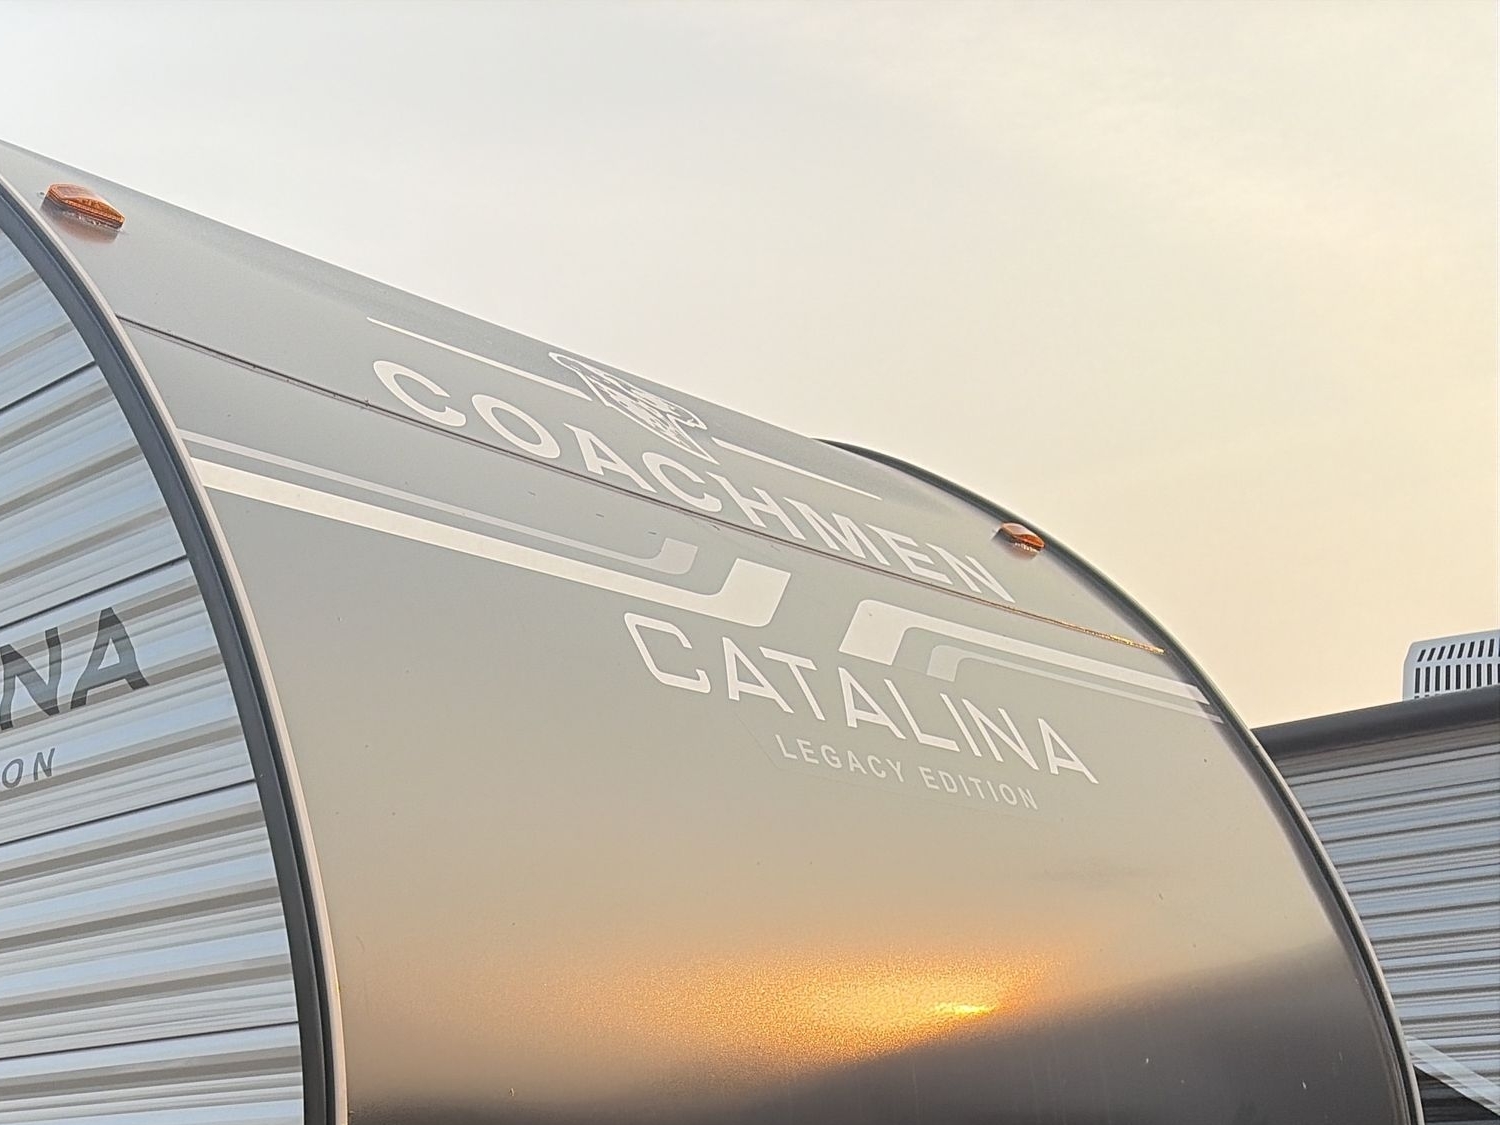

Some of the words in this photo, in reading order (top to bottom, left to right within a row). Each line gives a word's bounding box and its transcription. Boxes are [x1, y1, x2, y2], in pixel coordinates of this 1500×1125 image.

[373, 360, 1016, 603] COACHMEN
[623, 611, 1099, 785] CATALINA
[774, 732, 905, 785] LEGACY
[918, 767, 1039, 811] EDITION
